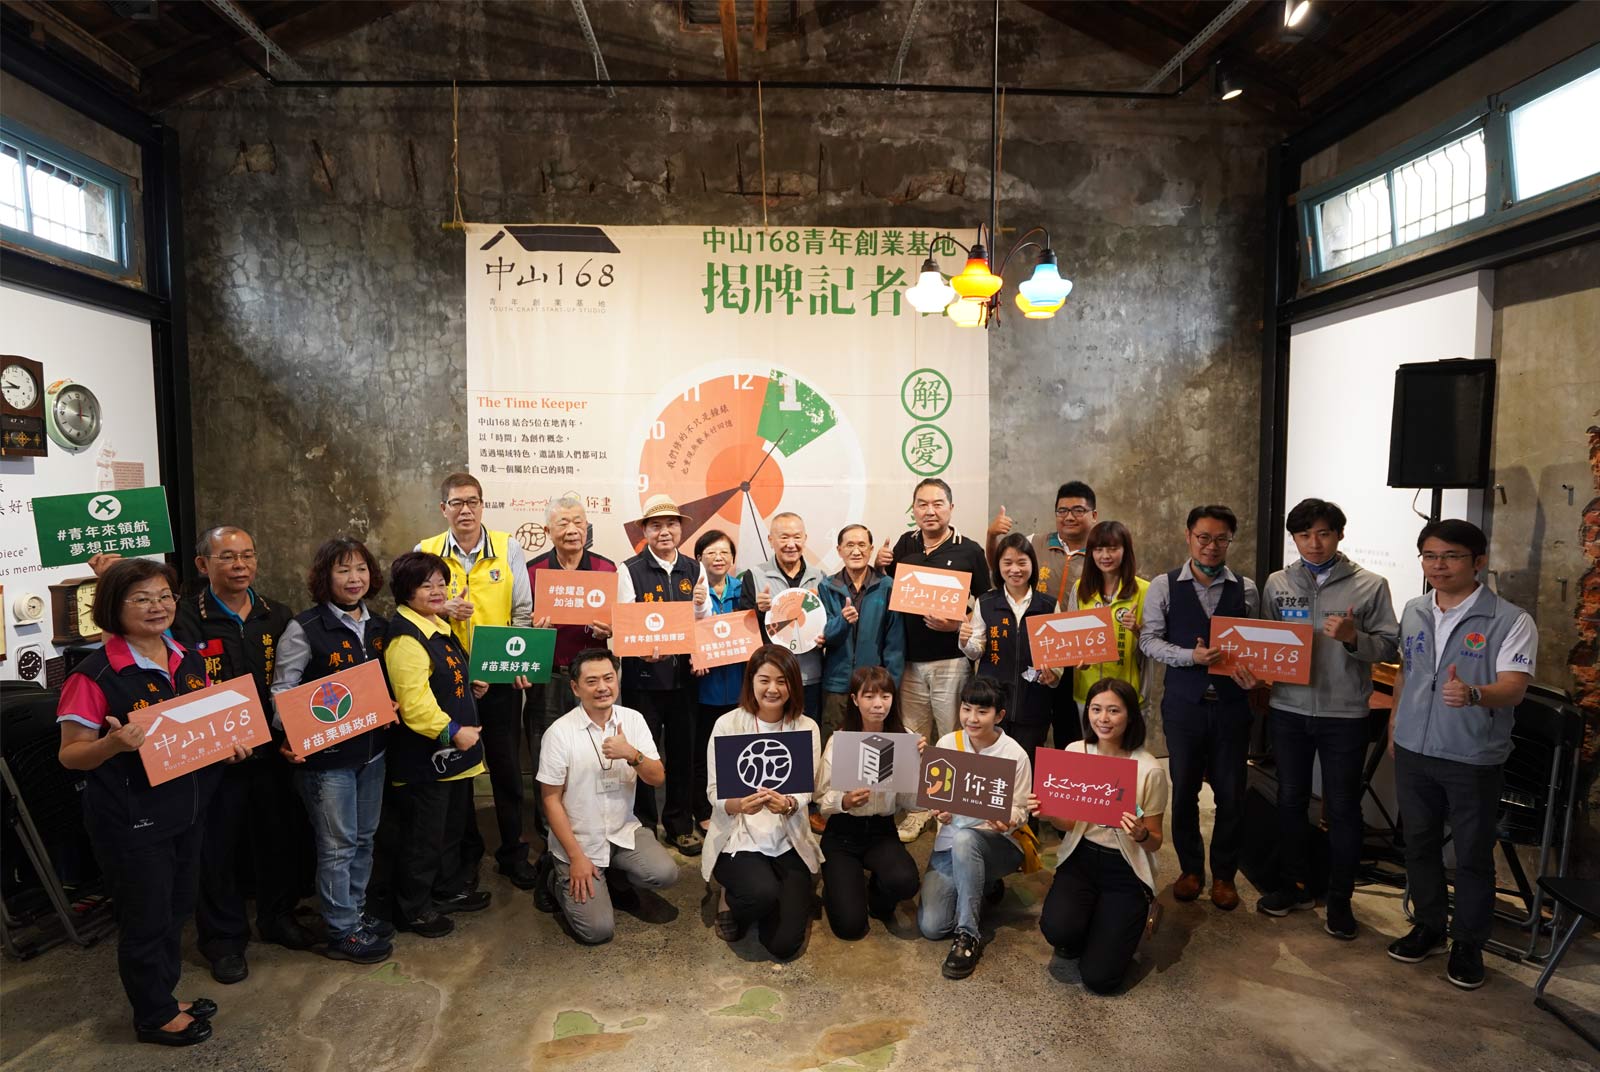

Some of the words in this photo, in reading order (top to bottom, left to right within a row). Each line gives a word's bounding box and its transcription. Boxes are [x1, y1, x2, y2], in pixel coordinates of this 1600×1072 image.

[702, 226, 957, 258] 中山168青年創業基地
[485, 256, 615, 292] 中山168
[701, 262, 958, 317] 揭牌記者
[733, 373, 754, 390] 12
[477, 396, 501, 408] The
[504, 397, 538, 409] Time
[542, 398, 588, 412] Keeper
[478, 418, 510, 427] 中山168
[57, 520, 150, 541] #青年來領航
[69, 535, 151, 556] 夢想正飛揚
[548, 585, 585, 596] #徐耀昌
[901, 583, 960, 604] 中山168
[790, 639, 797, 650] 6
[1039, 630, 1106, 654] 中山168
[1220, 641, 1300, 664] 中山168
[481, 660, 541, 673] #苗栗好青年
[154, 709, 251, 758] 中山168
[303, 712, 378, 751] #苗栗縣政府
[963, 772, 1009, 810] 你畫
